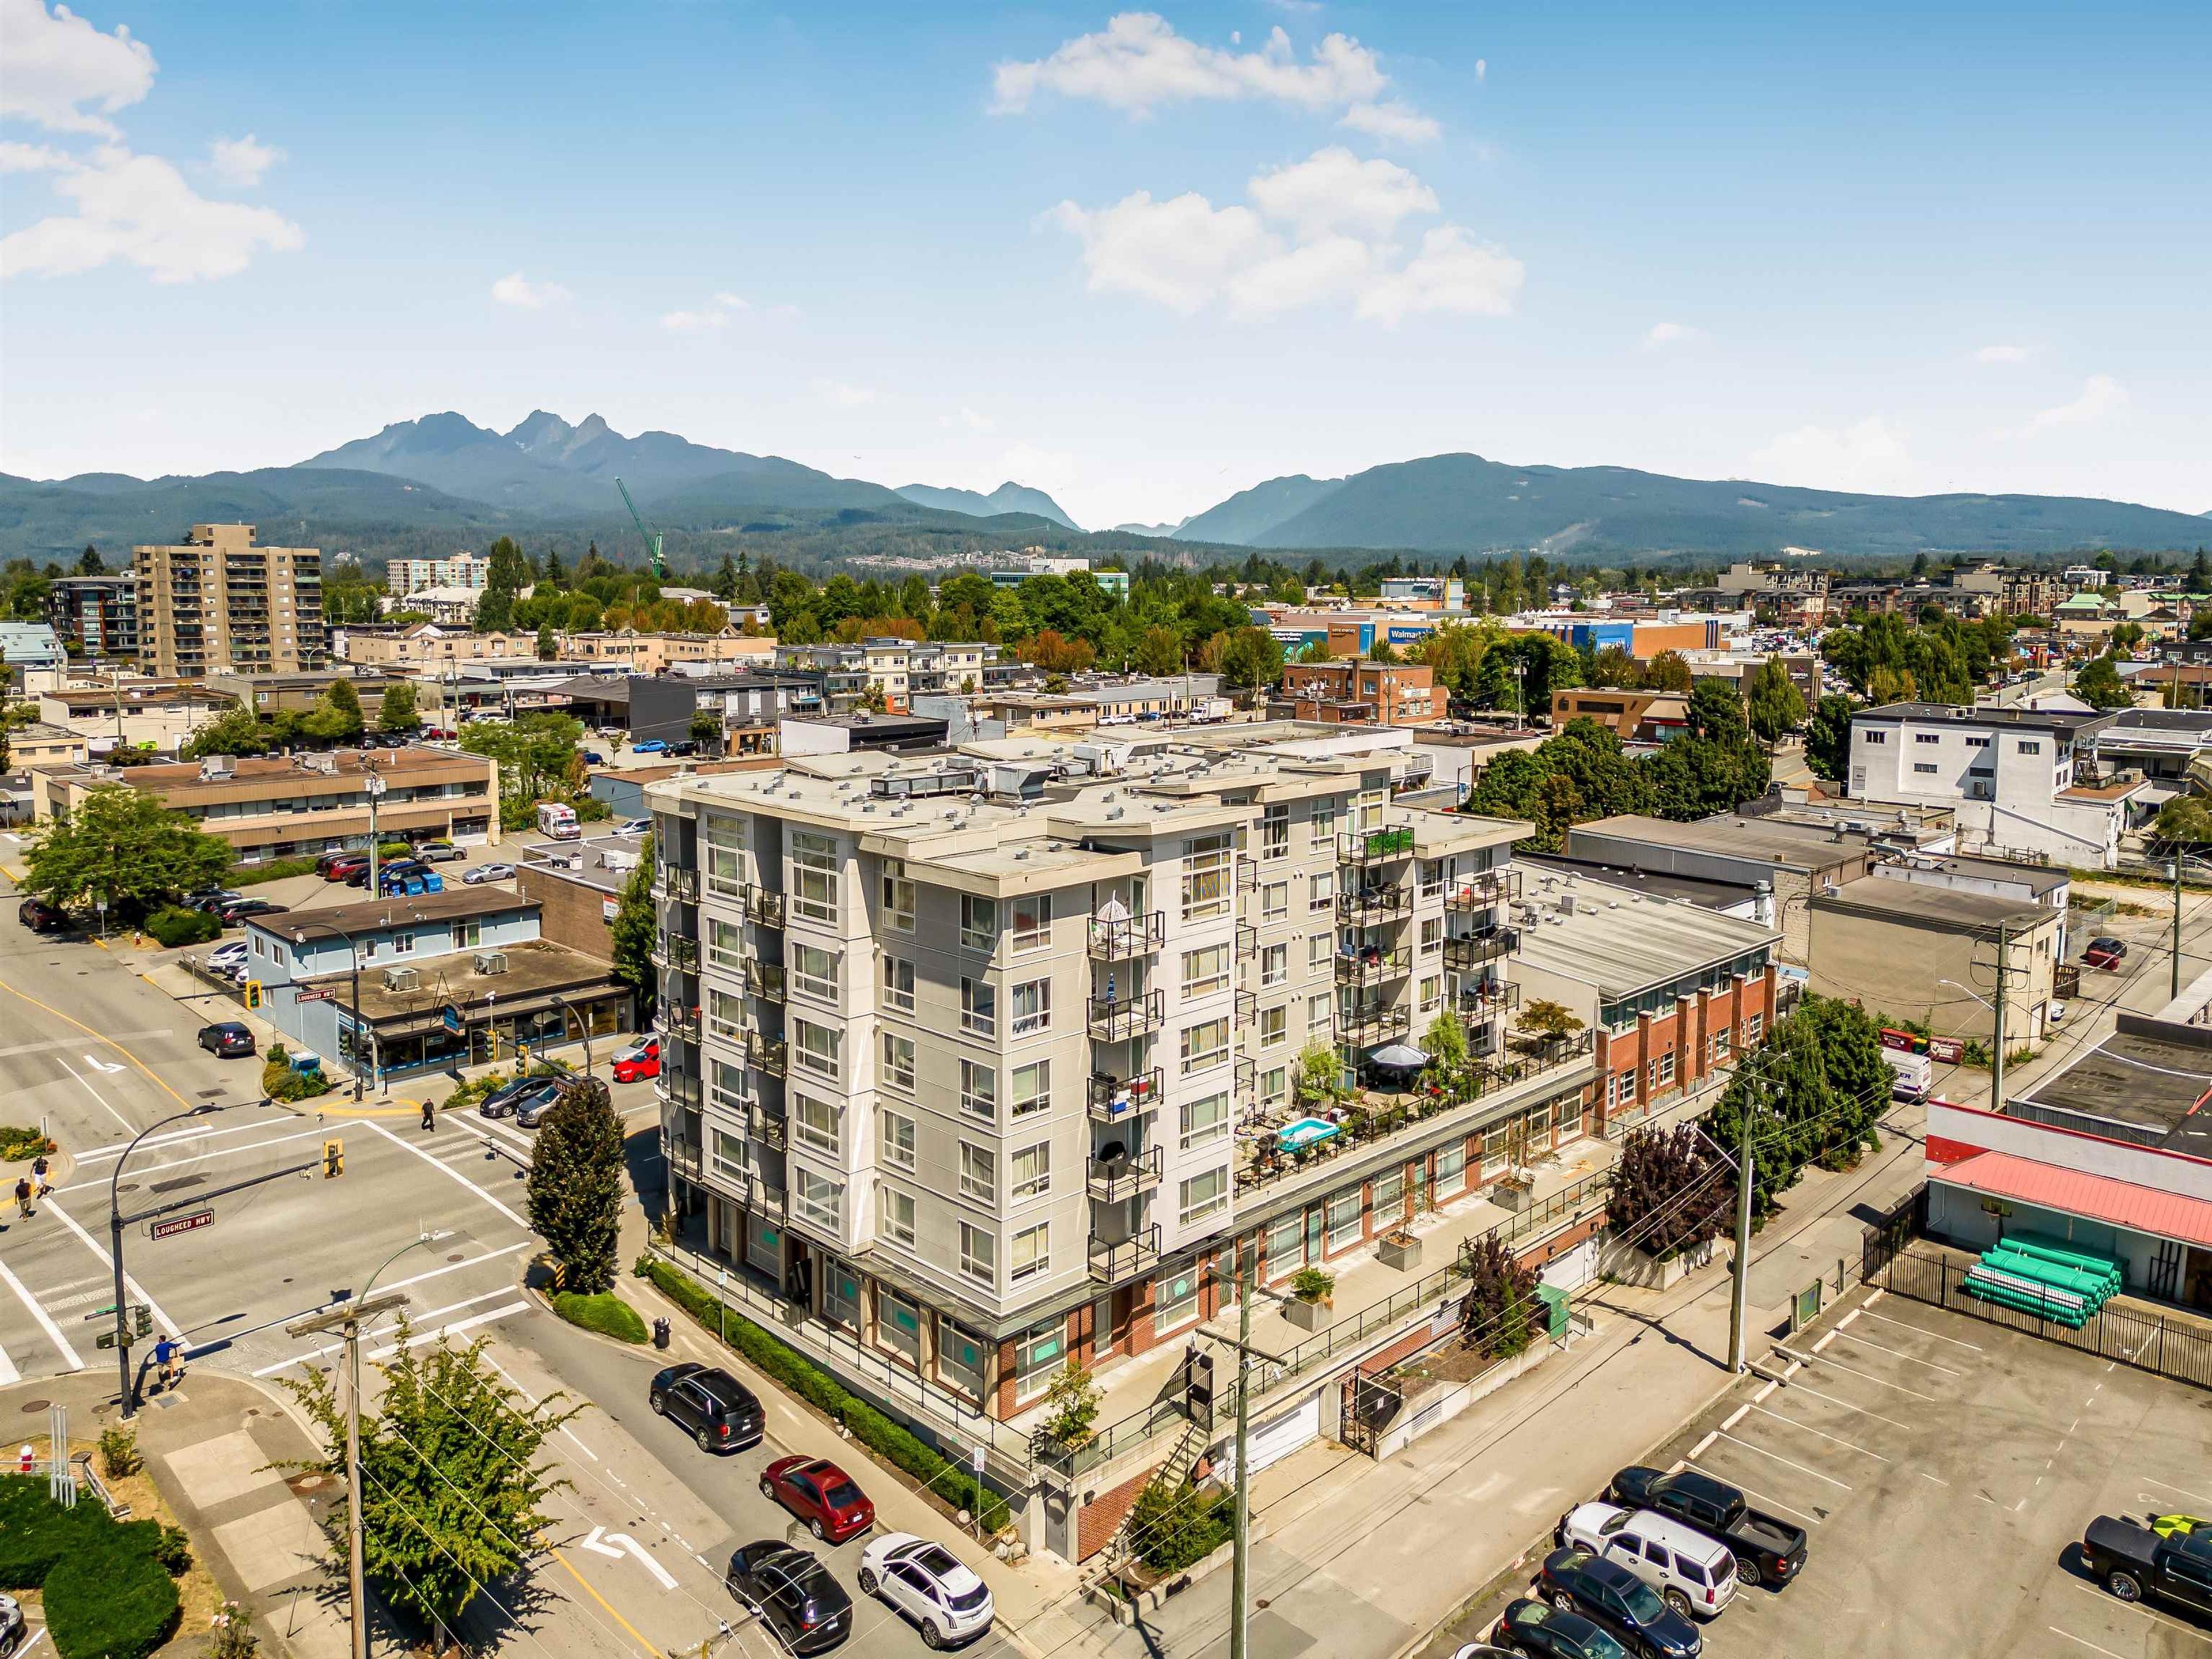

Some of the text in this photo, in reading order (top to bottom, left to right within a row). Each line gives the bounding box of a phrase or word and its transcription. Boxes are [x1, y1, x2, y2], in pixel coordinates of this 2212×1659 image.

[298, 993, 321, 1002] LOUGHEED
[157, 1215, 211, 1236] LOUGHEED HWY
